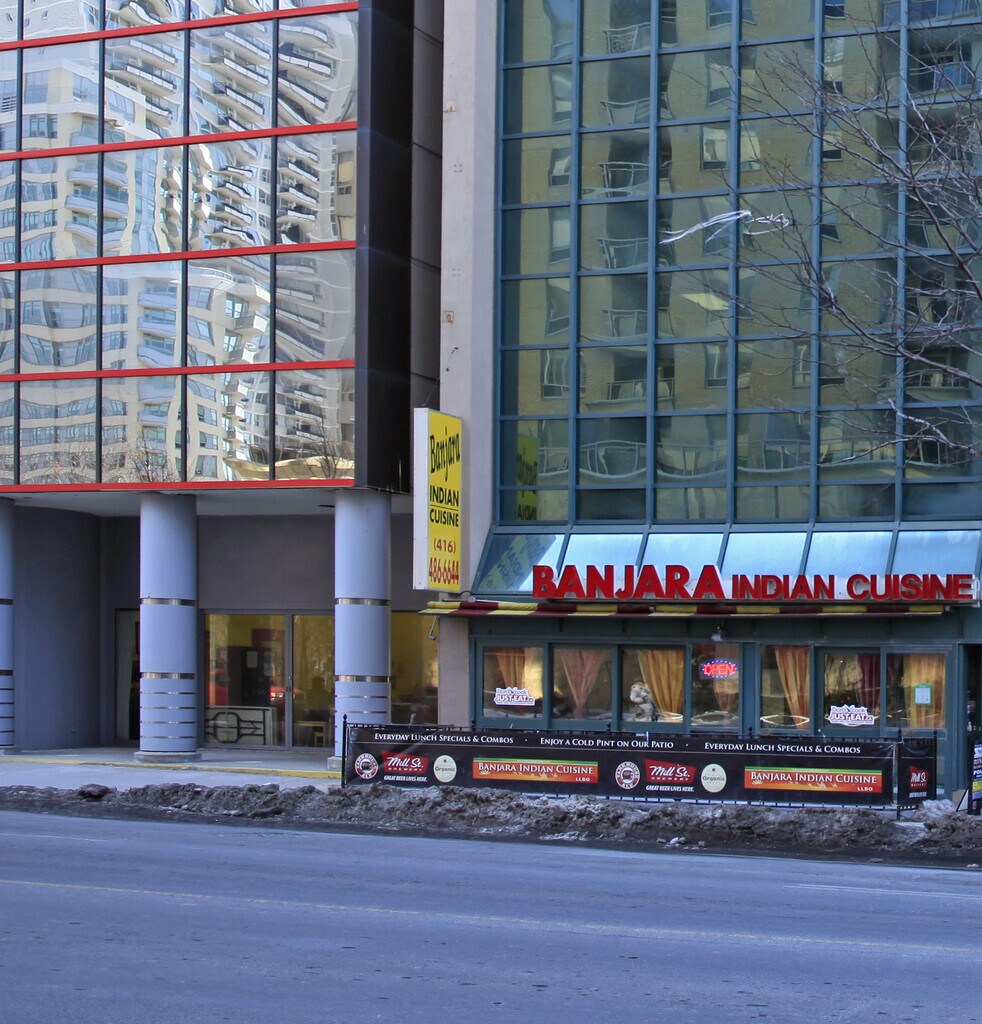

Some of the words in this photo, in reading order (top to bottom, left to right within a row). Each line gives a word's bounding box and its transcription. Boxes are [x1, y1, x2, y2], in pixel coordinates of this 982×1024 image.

[429, 426, 460, 482] Banjara
[429, 485, 459, 507] INDIAN
[429, 509, 459, 527] CUISINE
[433, 538, 456, 554] (416)
[429, 557, 459, 585] 486-6644
[532, 564, 726, 599] BANJARA
[731, 574, 835, 600] INDIAN
[847, 573, 974, 600] CUISINE
[704, 664, 735, 675] OPEN
[374, 733, 409, 741] EVERYDAY
[411, 733, 437, 741] LUNCH
[439, 734, 471, 743] SPECIALS
[472, 735, 479, 743] &
[480, 735, 514, 744] COMBOS
[540, 737, 564, 746] ENJOY
[571, 738, 594, 746] COLD
[596, 739, 615, 747] PINT
[631, 739, 649, 748] OUR
[651, 740, 674, 748] PATIO
[704, 742, 744, 751] EVERYDAY
[746, 743, 775, 752] LUNCH
[777, 744, 814, 753] SPECIALS
[815, 745, 822, 753] &
[824, 745, 861, 754] COMBOS
[387, 756, 411, 767] Mill
[410, 757, 424, 768] St.
[478, 762, 516, 772] BANJARA
[519, 763, 553, 773] INDIAN
[555, 765, 593, 774] CUISINE
[649, 765, 675, 776] Mill
[675, 766, 690, 777] St.
[751, 771, 792, 782] BANJARA
[795, 772, 832, 783] INDIAN
[835, 774, 877, 784] CUISINE
